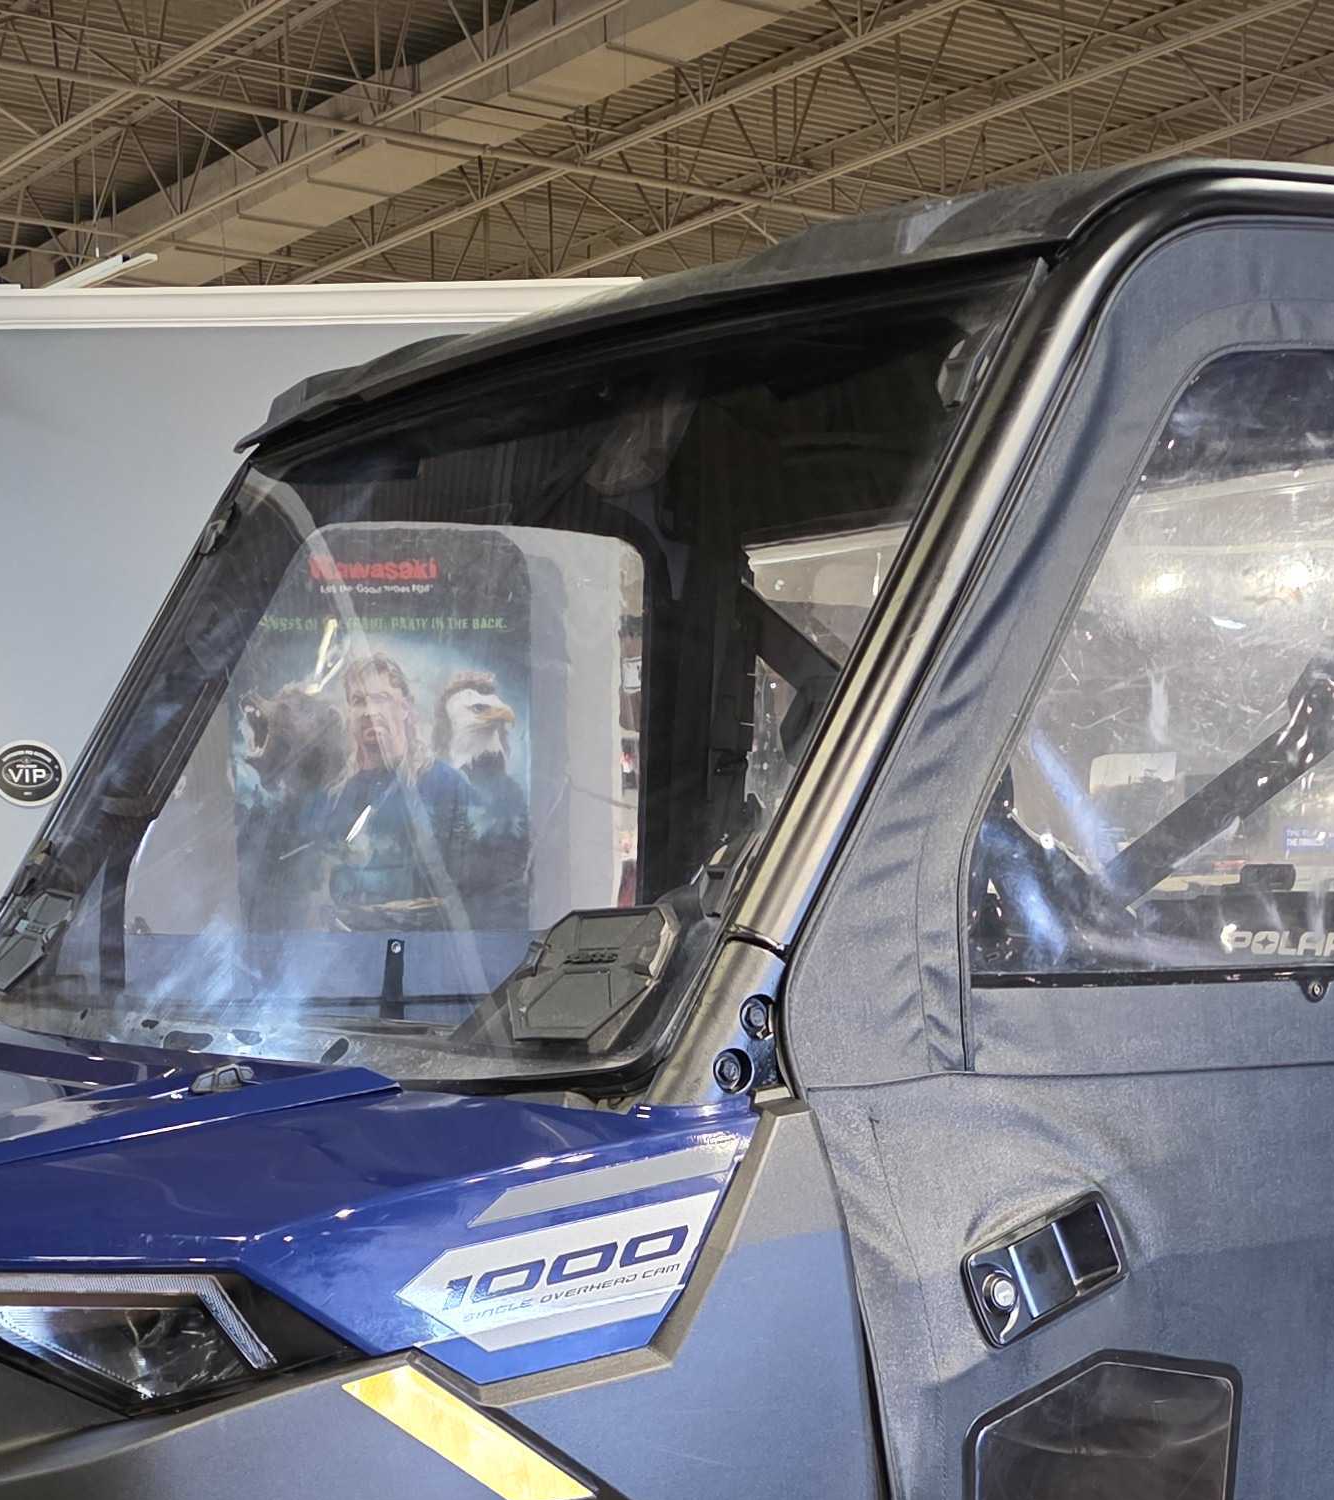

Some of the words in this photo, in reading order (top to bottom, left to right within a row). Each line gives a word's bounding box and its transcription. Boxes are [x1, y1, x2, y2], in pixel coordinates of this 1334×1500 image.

[310, 555, 439, 582] Kawasaki
[8, 768, 47, 783] VIP
[443, 1224, 689, 1311] 1000
[463, 1297, 533, 1323] SINGLE
[539, 1273, 638, 1304] OVERHEAD
[641, 1262, 681, 1279] CAM
